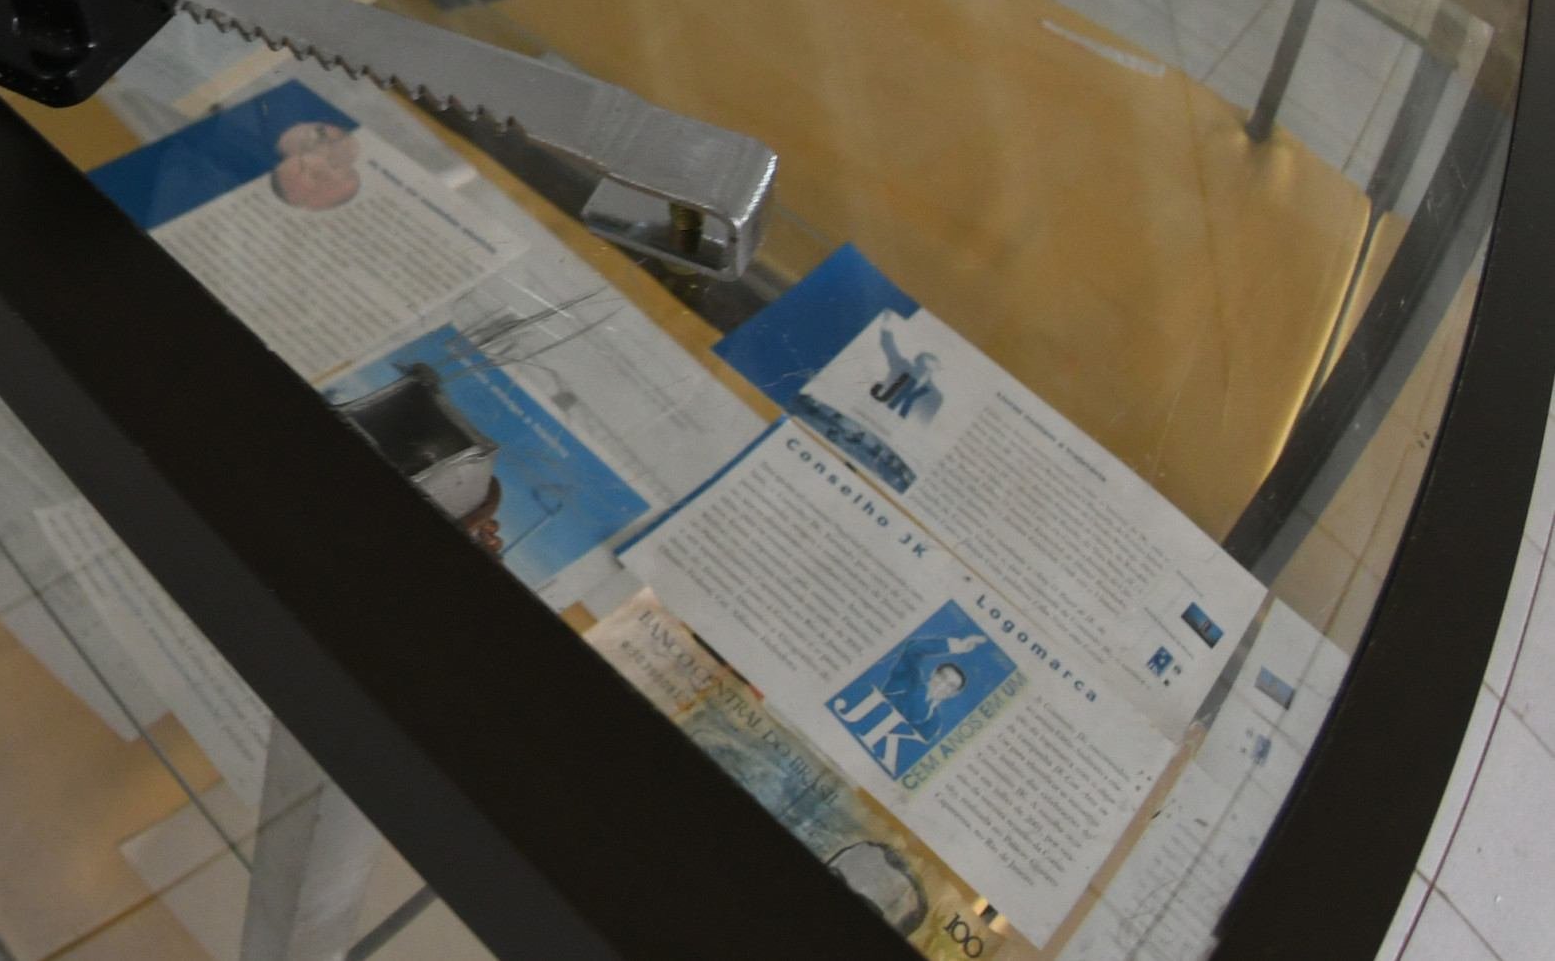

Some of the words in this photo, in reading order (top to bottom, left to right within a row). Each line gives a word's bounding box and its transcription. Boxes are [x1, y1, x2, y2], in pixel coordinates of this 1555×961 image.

[870, 372, 930, 419] JK
[786, 438, 889, 527] Conselho
[898, 532, 928, 559] JK
[975, 593, 1097, 703] Logomarca
[763, 729, 792, 758] DO
[834, 684, 930, 779] JK
[901, 751, 942, 791] CEM
[939, 717, 986, 760] ANOS
[978, 694, 1007, 720] EM
[1003, 670, 1029, 698] UM
[943, 912, 983, 959] 100
